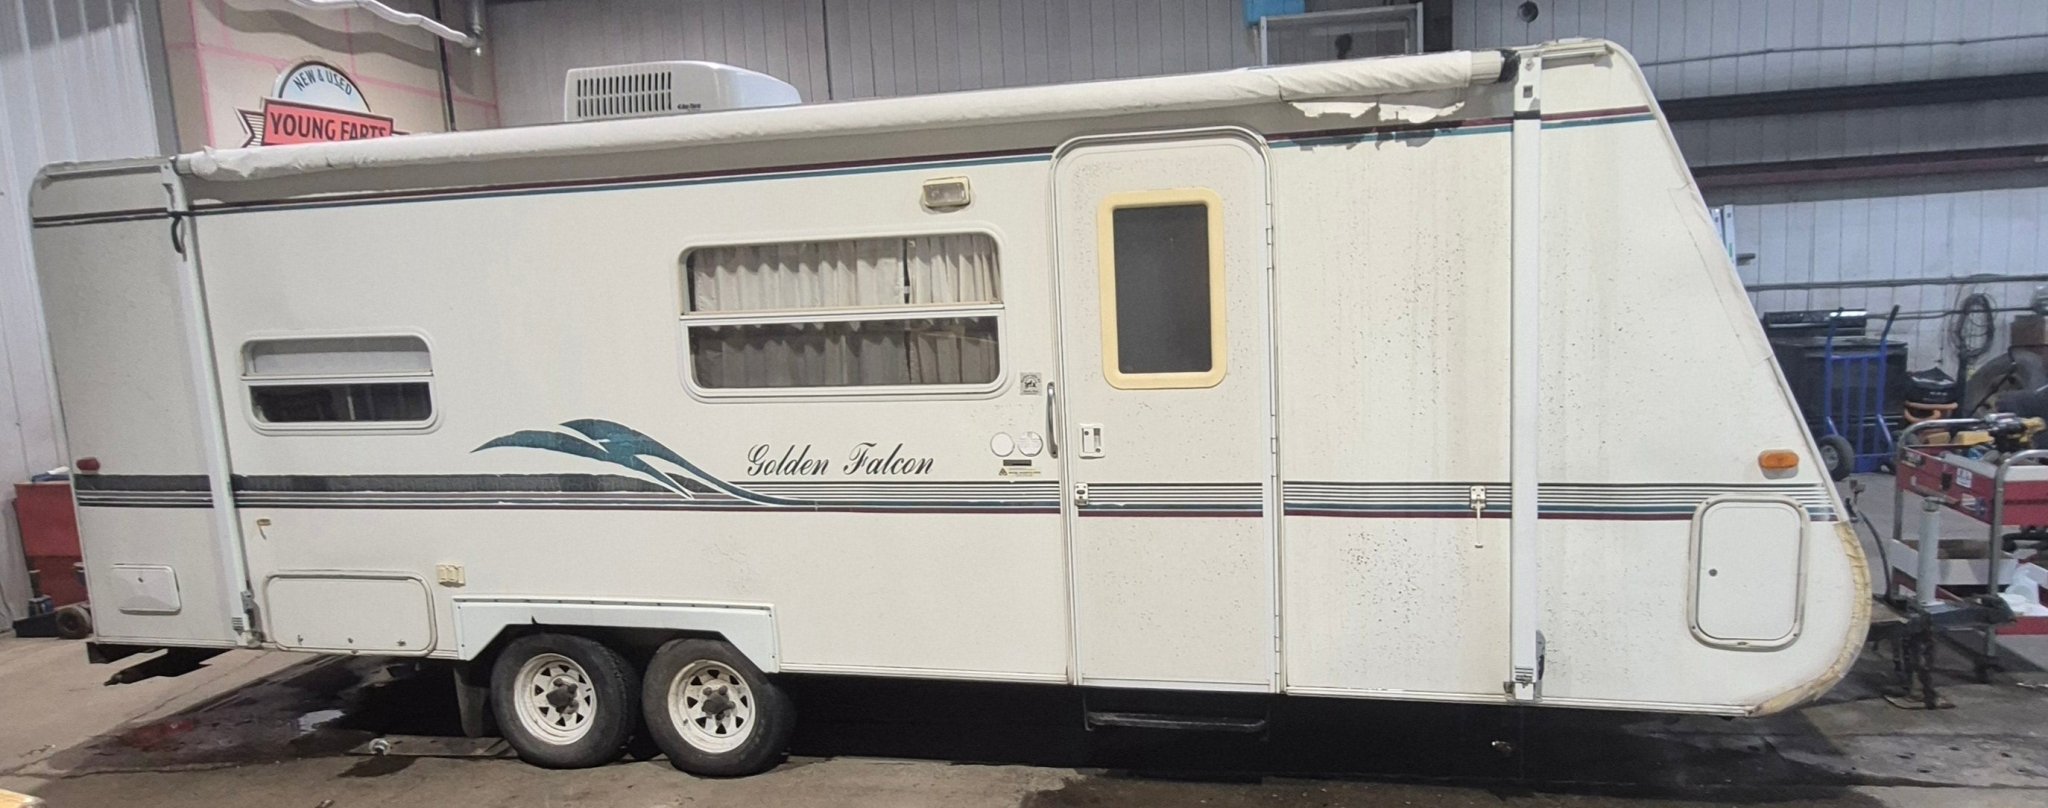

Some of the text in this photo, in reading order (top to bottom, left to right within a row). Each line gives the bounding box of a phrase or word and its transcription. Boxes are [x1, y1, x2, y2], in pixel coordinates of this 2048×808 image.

[293, 69, 317, 92] NEW
[325, 70, 352, 95] USED
[270, 112, 336, 141] YOUNG
[748, 442, 934, 477] Golden Falcon
